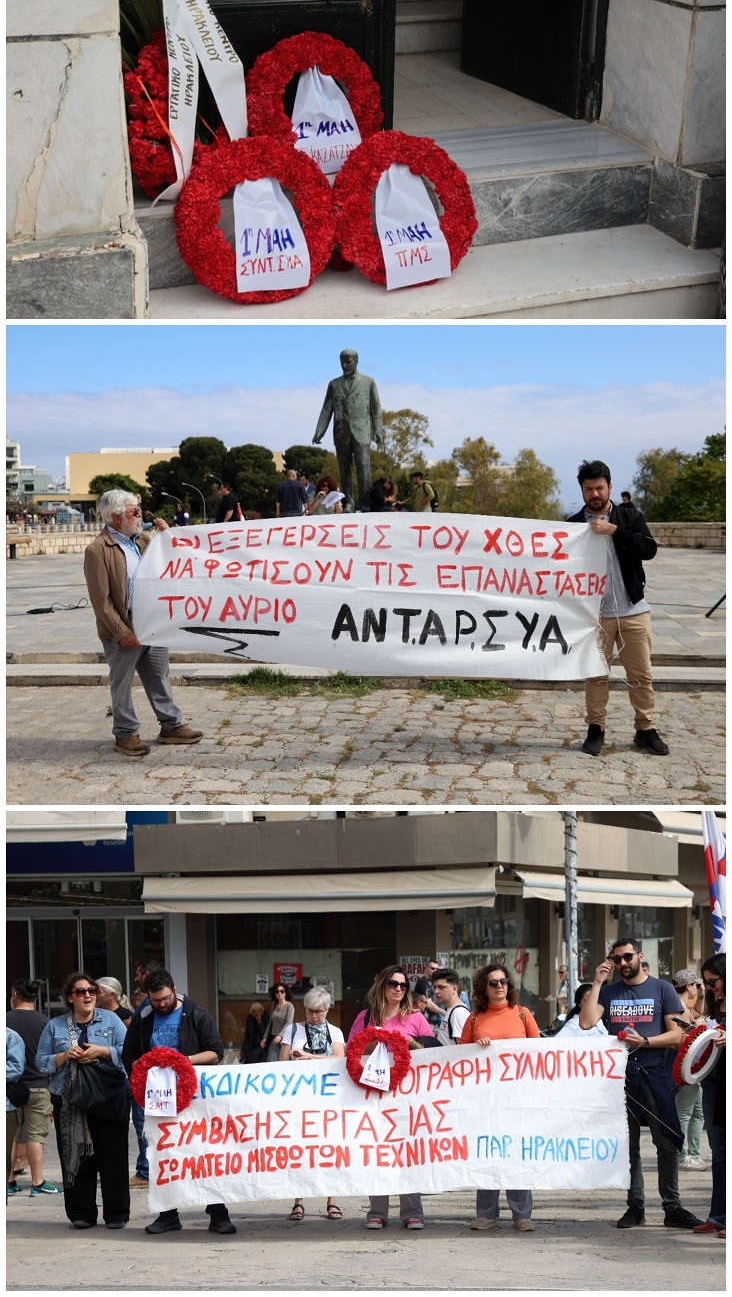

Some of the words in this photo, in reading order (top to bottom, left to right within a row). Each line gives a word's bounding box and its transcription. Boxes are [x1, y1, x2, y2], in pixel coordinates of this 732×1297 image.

[175, 32, 195, 107] ΗΡΑΚΛΕΙΟΥ
[169, 67, 181, 120] ΕΡΓΑΤΙΚΟ
[316, 119, 355, 137] ΜΑΗ
[255, 227, 296, 255] ΜΑΗ
[394, 221, 433, 243] ΜΑΗ
[207, 524, 392, 554] ΕΞΕΓΕΡΣΕΙΣ
[409, 525, 469, 555] ΤΟΥ
[483, 527, 569, 560] ΧΘΕΣ
[160, 558, 194, 579] ΝΑ
[204, 558, 353, 585] ΦΩΤΙΣΟΥΝ
[366, 561, 417, 587] ΤΙΣ
[436, 564, 607, 597] ΕΠΑΝΑΣΤΑΣΕΙΣ
[158, 595, 212, 622] ΤΟΥ
[218, 595, 297, 624] ΑΥΡΙΟ
[191, 1071, 340, 1100] ΚΔΙΚΟΥΜΕ
[364, 1056, 492, 1100] ΟΓΡΑΦΗ
[499, 1049, 625, 1081] ΣΥΛΛΟΓΙΚΗΣ
[149, 1101, 169, 1110] ΣΜΤ
[156, 1110, 291, 1151] ΣΥΜΒΑΣΗΣ
[302, 1100, 453, 1143] ΕΡΓΑΣΙΑΣ
[156, 1152, 243, 1186] ΣΩΜΑΤΕΙΟ
[247, 1145, 351, 1173] ΜΙΣΘΩΤΩΝ
[359, 1135, 469, 1169] ΤΕΧΝΙΚΩΝ
[477, 1134, 513, 1159] ΠΑΡ.
[521, 1135, 619, 1163] ΗΡΑΚΛΕΙΟΥ
